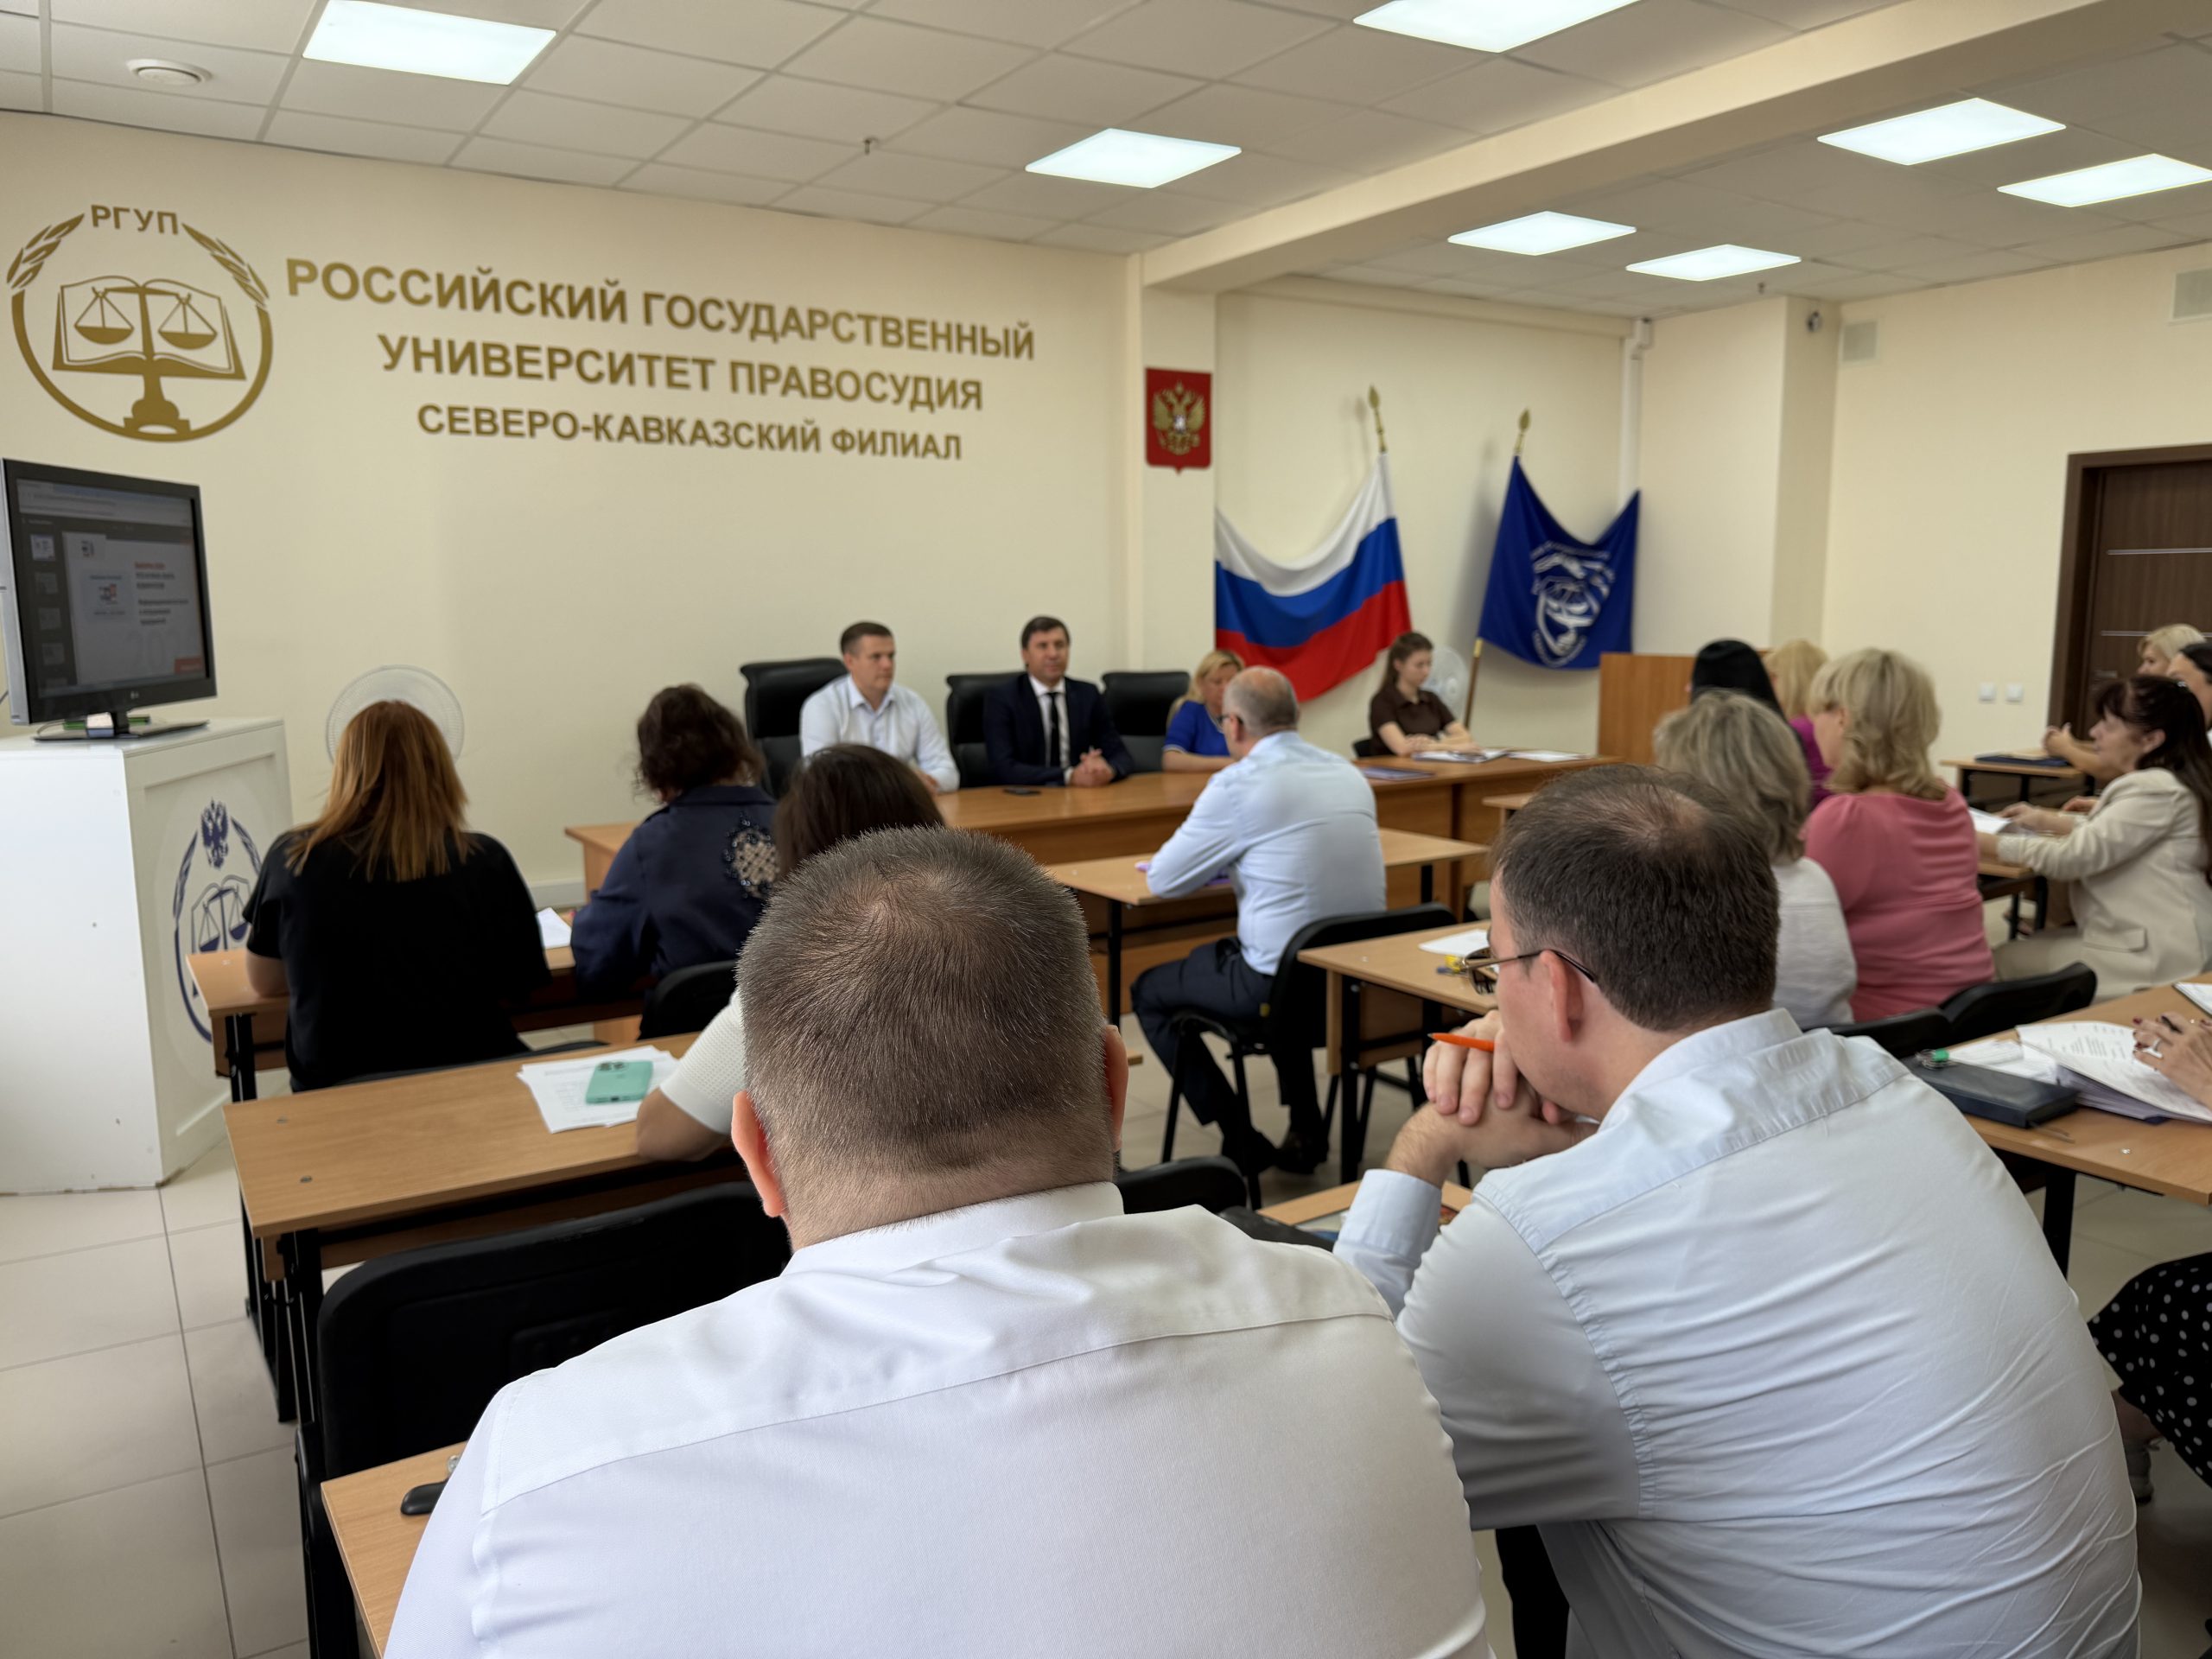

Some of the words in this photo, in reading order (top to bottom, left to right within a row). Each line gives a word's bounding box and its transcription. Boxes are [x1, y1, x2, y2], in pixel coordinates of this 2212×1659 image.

[91, 204, 179, 235] РГУП
[286, 258, 627, 324] РОССИЙСКИЙ
[642, 292, 1034, 360] ГОСУДАРСТВЕННЫЙ
[377, 334, 716, 391] УНИВЕРСИТЕТ
[729, 360, 983, 413] ПРАВОСУДИЯ
[417, 404, 821, 453] СЕВЕРО-КАВКАЗСКИЙ
[831, 429, 962, 461] ФИЛИАЛ
